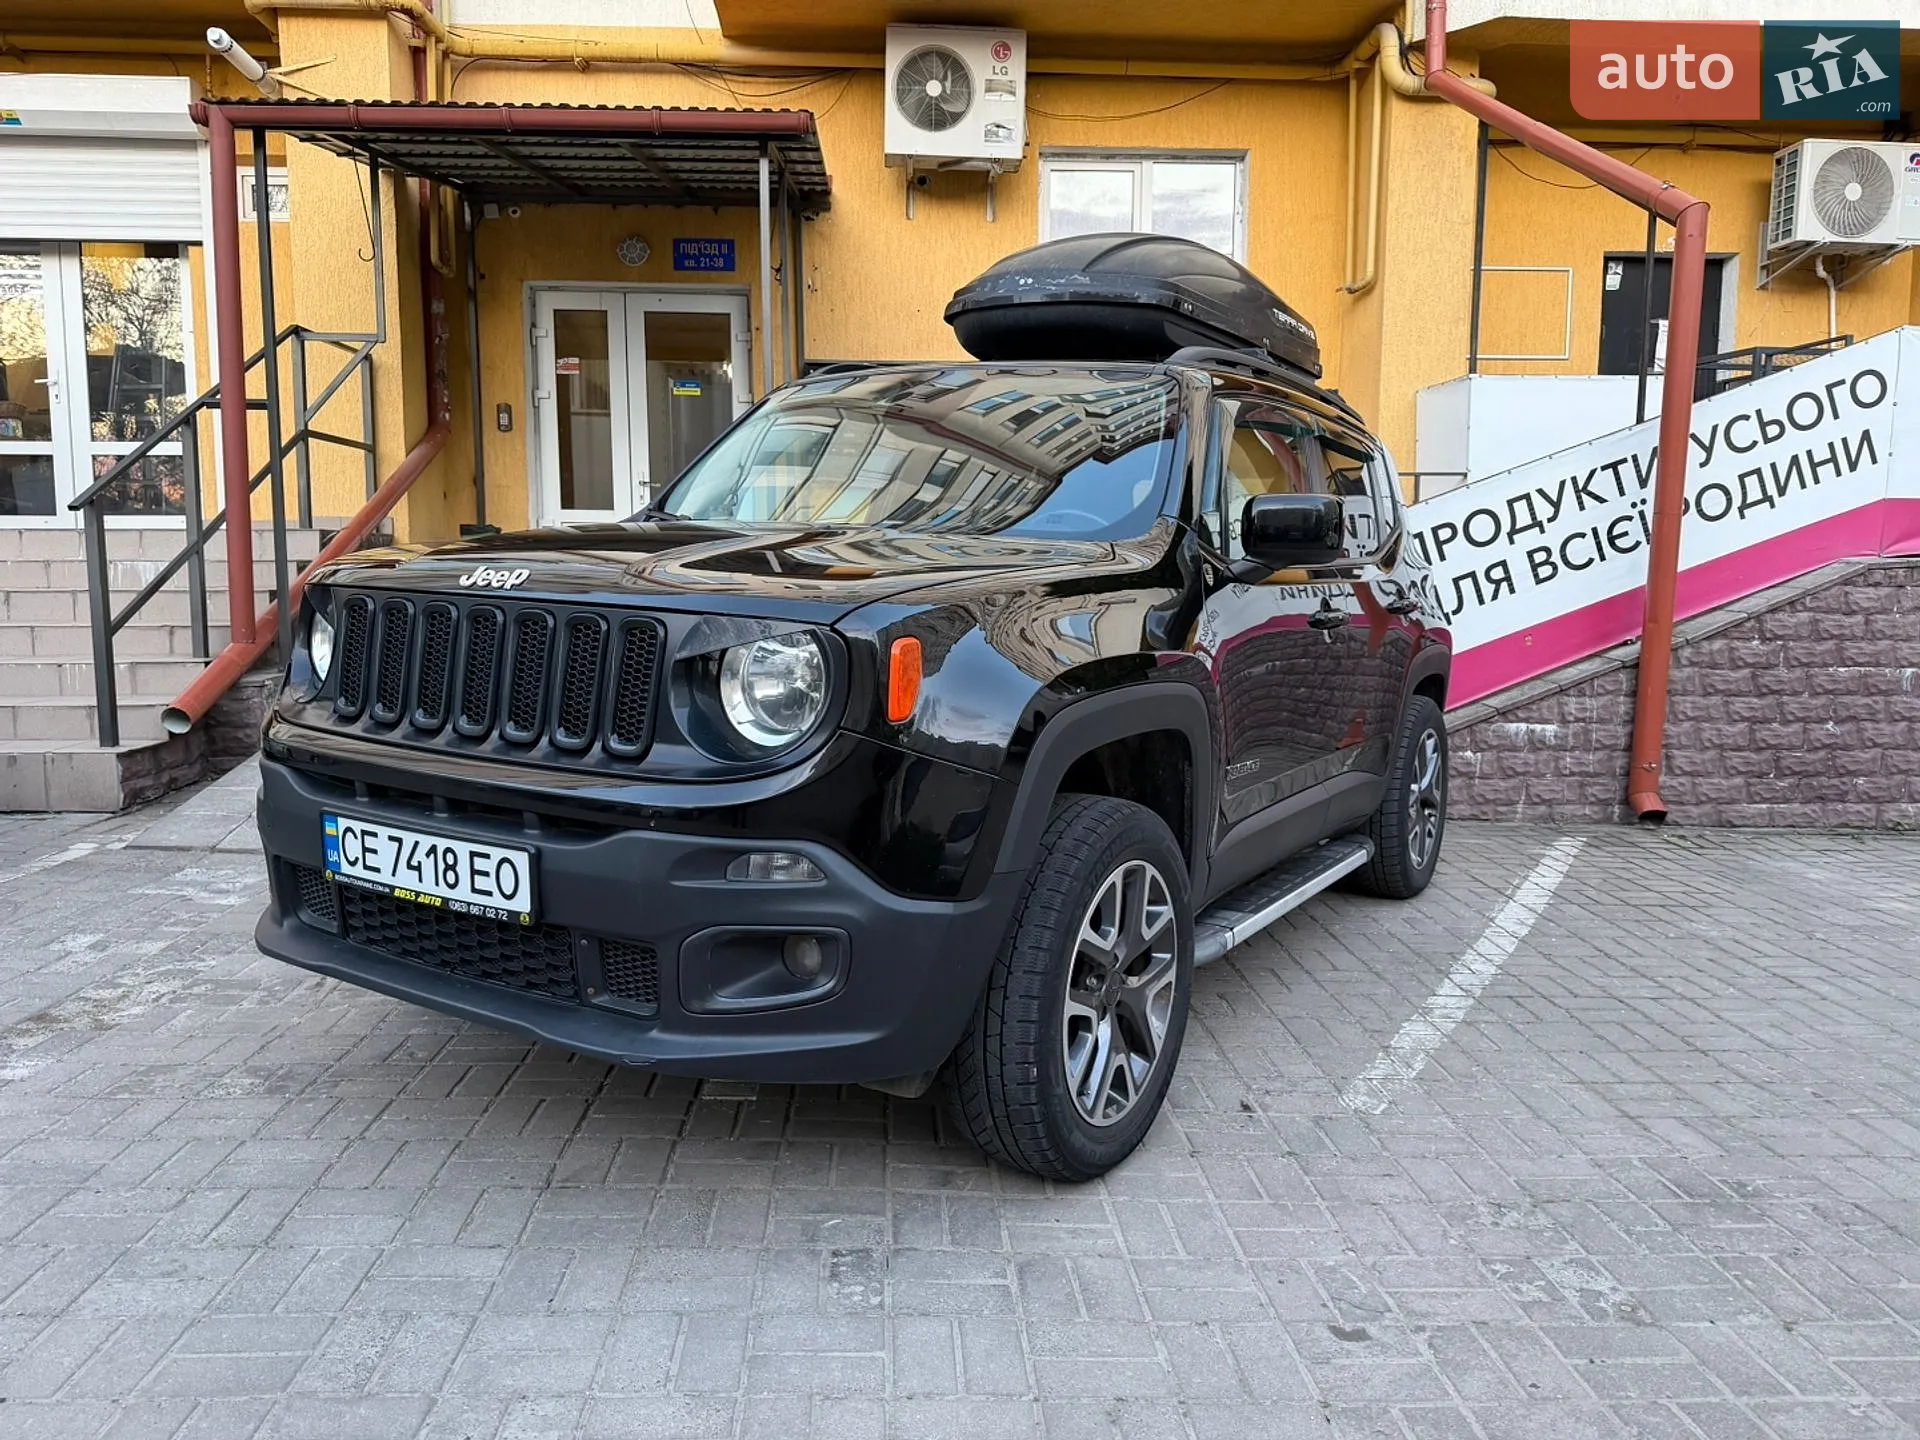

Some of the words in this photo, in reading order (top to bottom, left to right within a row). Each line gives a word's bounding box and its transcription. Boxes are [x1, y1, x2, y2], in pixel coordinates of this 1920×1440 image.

[992, 65, 1009, 76] LG
[700, 257, 724, 268] 21-38
[1690, 368, 1888, 469] УСЬОГО
[1526, 498, 1652, 587] ВСІЄЇ
[1682, 429, 1879, 522] ОДИНИ
[459, 565, 531, 590] Jeep
[327, 848, 340, 863] UA
[341, 826, 382, 874] CE
[388, 835, 460, 890] 7418
[469, 850, 520, 901] EO
[394, 888, 416, 900] BOSS
[417, 893, 442, 907] AUTO
[469, 904, 484, 916] 667
[485, 908, 497, 919] 02
[497, 909, 509, 920] 72
